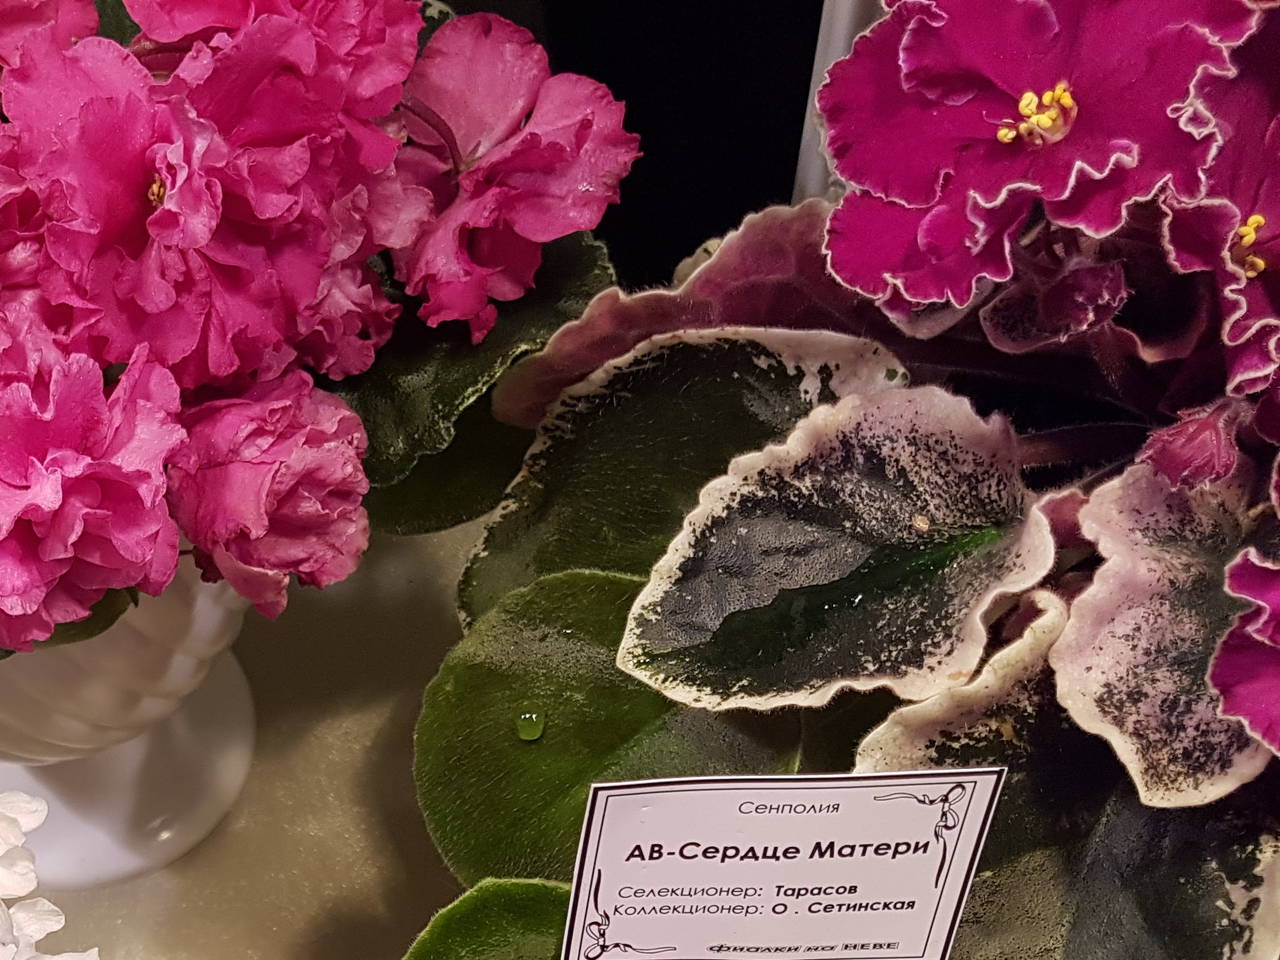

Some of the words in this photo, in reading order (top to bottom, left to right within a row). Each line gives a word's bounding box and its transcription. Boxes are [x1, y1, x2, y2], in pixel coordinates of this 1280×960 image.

[738, 801, 840, 814] Сенполия
[625, 841, 801, 863] АВ-Сердце
[808, 841, 930, 860] Матери
[618, 886, 763, 899] Селекционер:
[775, 885, 858, 899] Тарасов
[613, 904, 764, 917] Коллекционер:
[807, 900, 916, 914] Сетинская
